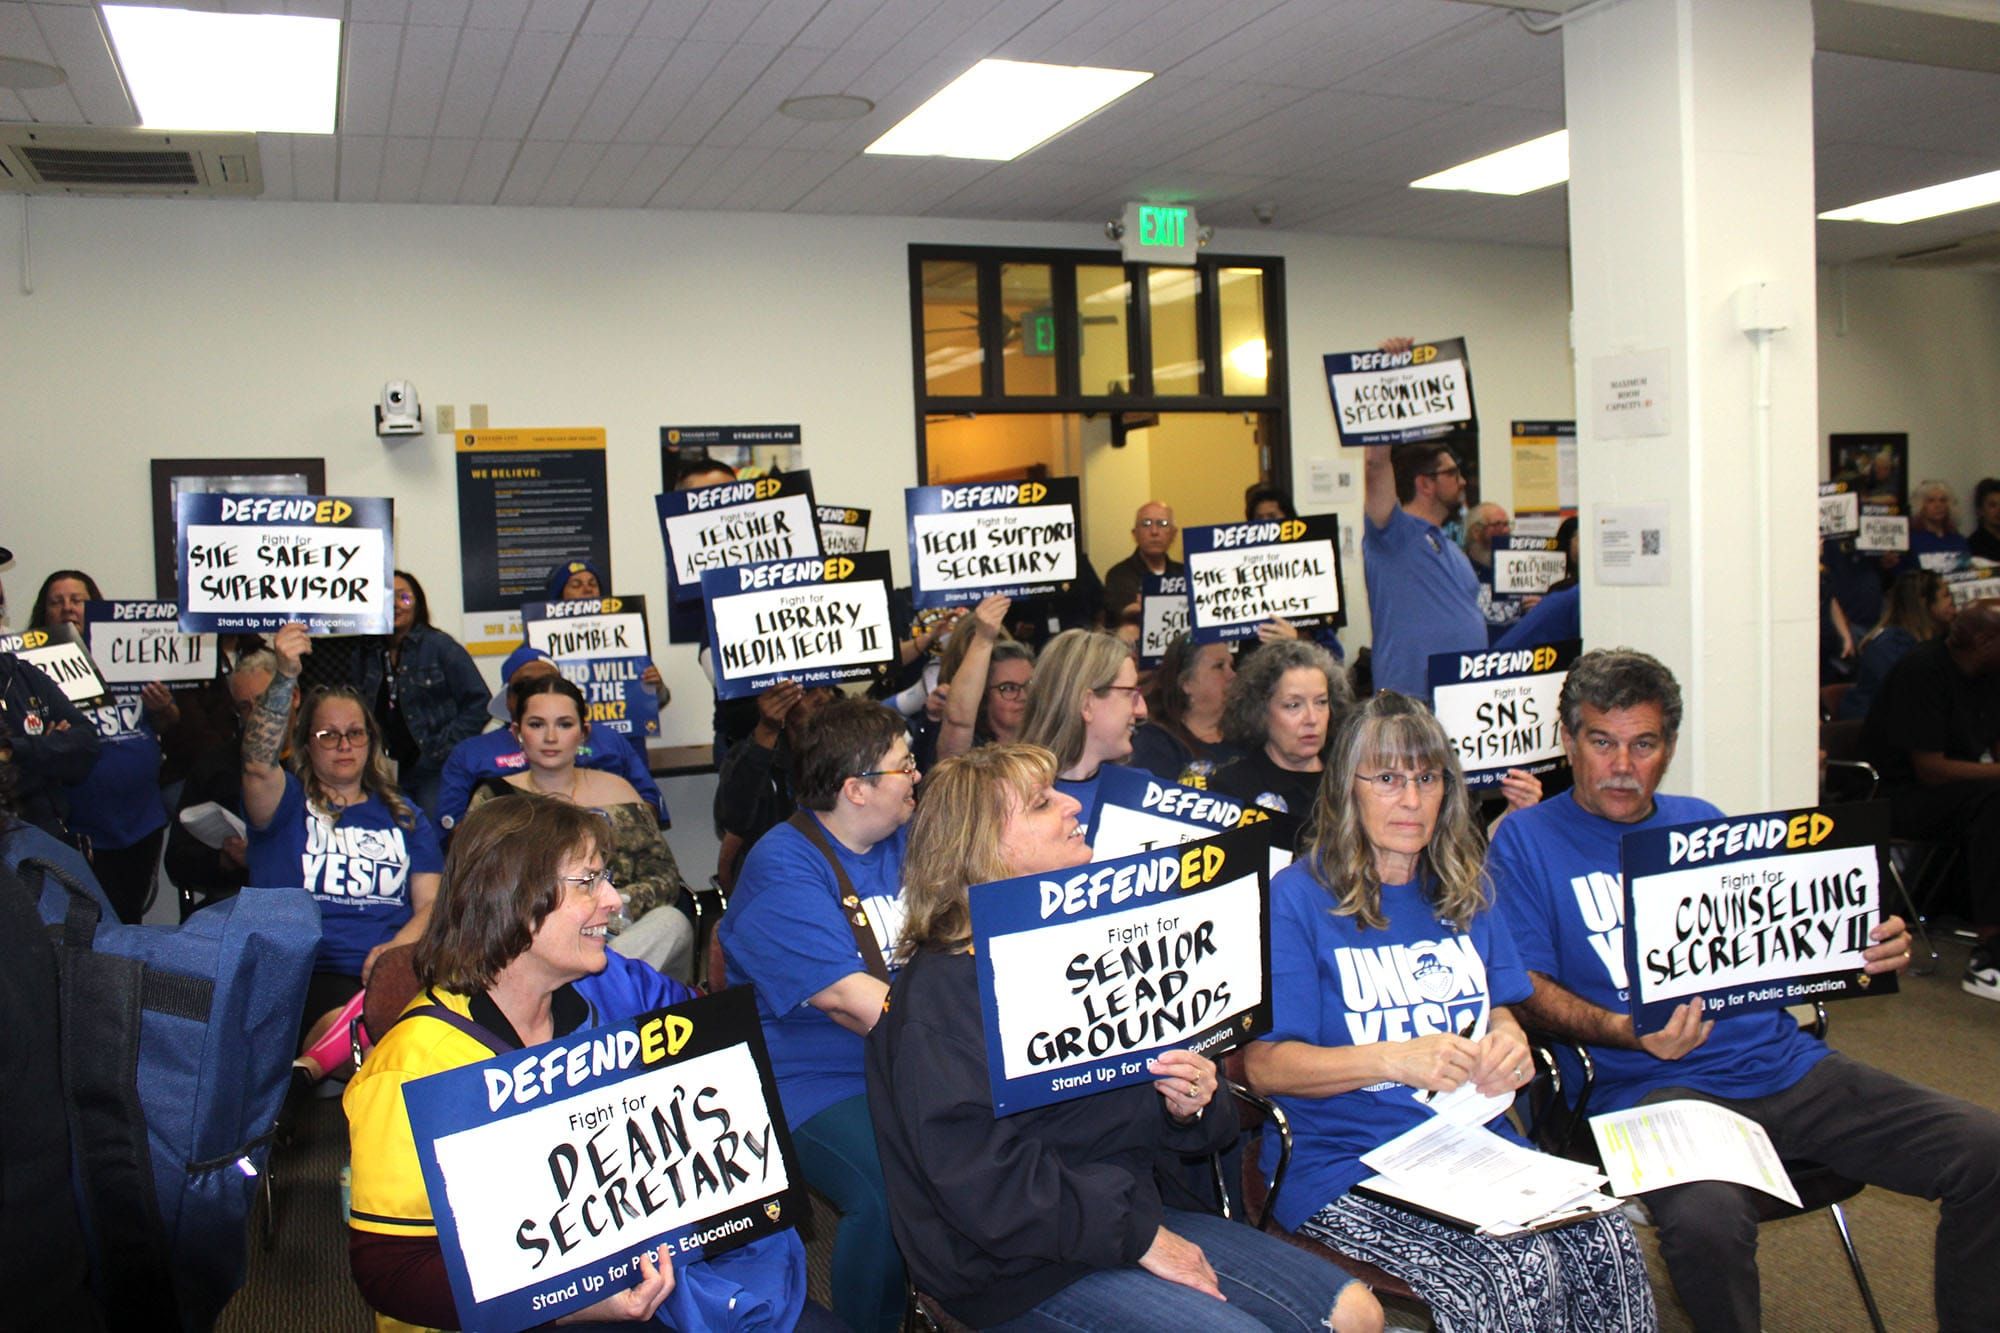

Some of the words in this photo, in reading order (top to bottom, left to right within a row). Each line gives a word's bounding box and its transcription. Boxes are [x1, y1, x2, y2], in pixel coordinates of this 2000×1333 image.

[1139, 206, 1188, 247] EXIT
[1351, 345, 1438, 371] DEFENDED
[1354, 374, 1455, 403] ACCOUNTING
[1344, 393, 1455, 425] SPECIALIST
[471, 469, 487, 479] WE
[687, 478, 781, 511] DEFENDED
[941, 482, 1048, 510] DEFENDED
[221, 498, 352, 523] DEFENDED
[977, 516, 1000, 527] Fight
[1004, 516, 1018, 525] for
[262, 534, 290, 546] Fight
[295, 534, 312, 545] for
[697, 510, 793, 549] TEACHER
[922, 528, 977, 555] TECH
[988, 522, 1073, 547] SUPPORT
[1213, 520, 1307, 548] DEFENDED
[190, 541, 238, 568] SITE
[257, 543, 360, 570] SAFETY
[686, 533, 795, 578] ASSISTANT
[937, 551, 1061, 581] SECRETARY
[201, 574, 369, 602] SUPERVISOR
[739, 557, 855, 591] DEFENDED
[1193, 567, 1228, 588] SITE
[1234, 557, 1326, 585] TECHNICAL
[113, 603, 178, 620] DEFEND
[546, 598, 622, 618] DEFENDED
[780, 595, 805, 606] Fight
[810, 594, 824, 603] for
[1196, 583, 1268, 611] SUPPORT
[1212, 595, 1318, 622] SPECIALIST
[217, 618, 243, 627] Stand
[247, 618, 259, 628] Up
[263, 618, 276, 627] for
[309, 618, 355, 627] Education
[755, 600, 862, 635] LIBRARY
[111, 635, 180, 664] CLERK
[184, 634, 201, 665] II
[548, 624, 629, 657] PLUMBER
[722, 635, 787, 670] MEDIA
[788, 628, 842, 661] TECH
[857, 624, 883, 653] II
[562, 663, 590, 683] HO
[593, 661, 638, 682] WILL
[751, 678, 775, 689] Stand
[791, 674, 803, 683] for
[805, 671, 830, 681] Public
[831, 668, 871, 679] Education
[1459, 646, 1557, 680] DEFENDED
[590, 681, 625, 701] THE
[1494, 688, 1516, 698] Fight
[1520, 687, 1532, 695] for
[584, 701, 627, 721] ORK?
[1476, 698, 1539, 733] SNS
[1482, 774, 1493, 784] Up
[305, 816, 406, 863] UNION
[1669, 812, 1834, 866] DEFENDED
[302, 853, 373, 897] YES
[1039, 844, 1225, 920] DEFENDED
[1721, 872, 1755, 891] Fight
[1762, 870, 1784, 884] for
[1675, 867, 1868, 944] COUNSELING
[1108, 922, 1150, 945] Fight
[1157, 915, 1180, 932] for
[1065, 919, 1218, 996] SENIOR
[1646, 913, 1839, 986] SECRETARY
[1840, 907, 1880, 953] II
[1334, 935, 1487, 1012] UNION
[1083, 970, 1189, 1026] LEAD
[1709, 999, 1725, 1010] Up
[1729, 995, 1744, 1006] for
[1748, 988, 1784, 1002] Public
[1787, 980, 1847, 997] Education
[1026, 981, 1232, 1066] GROUNDS
[483, 1014, 694, 1112] DEFENDED
[1051, 1072, 1092, 1092] Stand
[1096, 1066, 1116, 1084] Up
[1121, 1062, 1142, 1076] for
[569, 1105, 615, 1131] Fight
[622, 1094, 648, 1112] for
[547, 1085, 731, 1202] DEAN'S
[516, 1123, 771, 1269] SECRETARY
[532, 1284, 578, 1311] Stand
[582, 1274, 605, 1294] Up
[609, 1263, 629, 1281] for
[679, 1216, 754, 1251] Education
